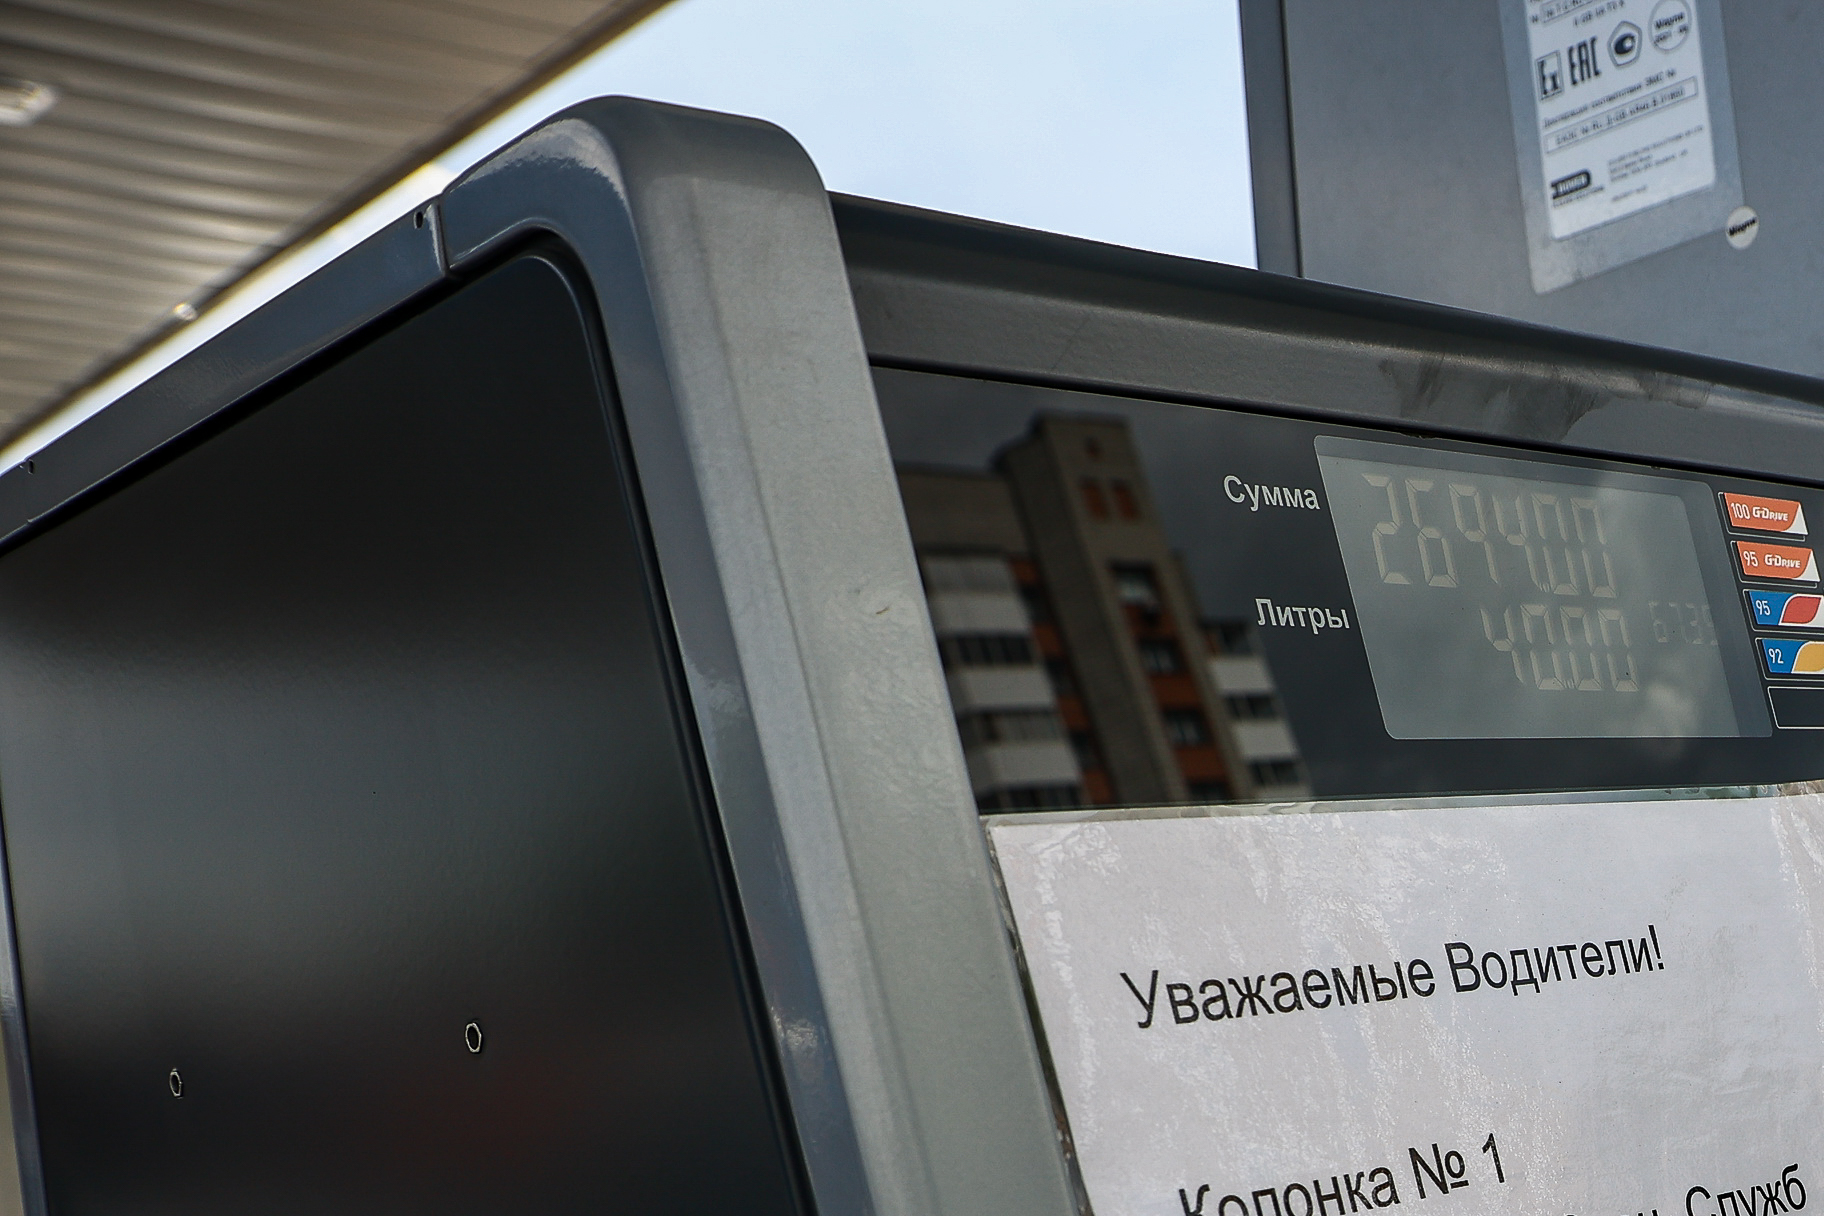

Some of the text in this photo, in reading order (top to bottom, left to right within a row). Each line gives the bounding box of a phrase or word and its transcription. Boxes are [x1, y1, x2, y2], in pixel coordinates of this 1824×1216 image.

[1223, 475, 1321, 511] Сумма
[1730, 503, 1751, 520] 100
[1743, 551, 1759, 567] 95
[1255, 598, 1351, 635] Литры
[1755, 600, 1771, 616] 95
[1768, 648, 1784, 664] 92
[1120, 924, 1666, 1030] Уважаемые Водители!
[1408, 1142, 1470, 1200] №
[1481, 1133, 1507, 1184] 1
